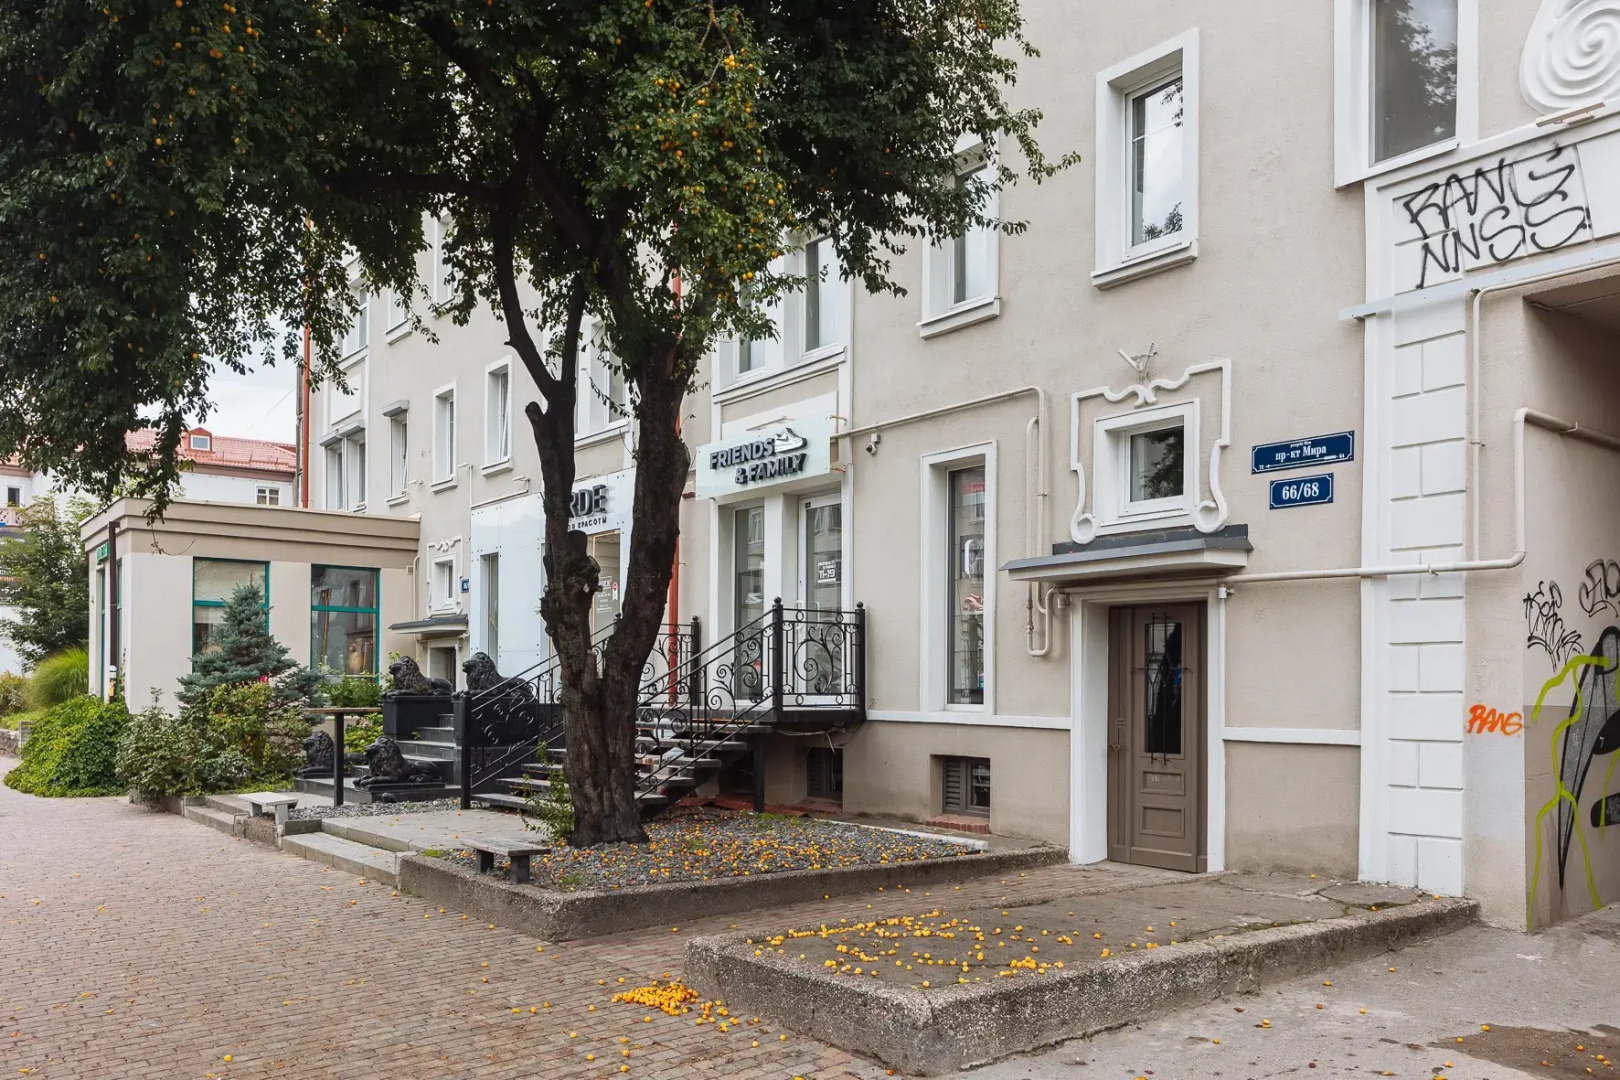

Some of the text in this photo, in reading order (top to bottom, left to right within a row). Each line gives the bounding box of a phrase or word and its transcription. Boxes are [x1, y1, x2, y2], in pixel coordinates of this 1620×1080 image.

[710, 438, 775, 469] FRIENDS
[1275, 445, 1327, 462] пр-кт Мира
[735, 453, 807, 484] & FAMILY
[569, 484, 608, 518] RDE
[1282, 482, 1319, 500] 66/68
[577, 516, 607, 528] КРАСОТЫ
